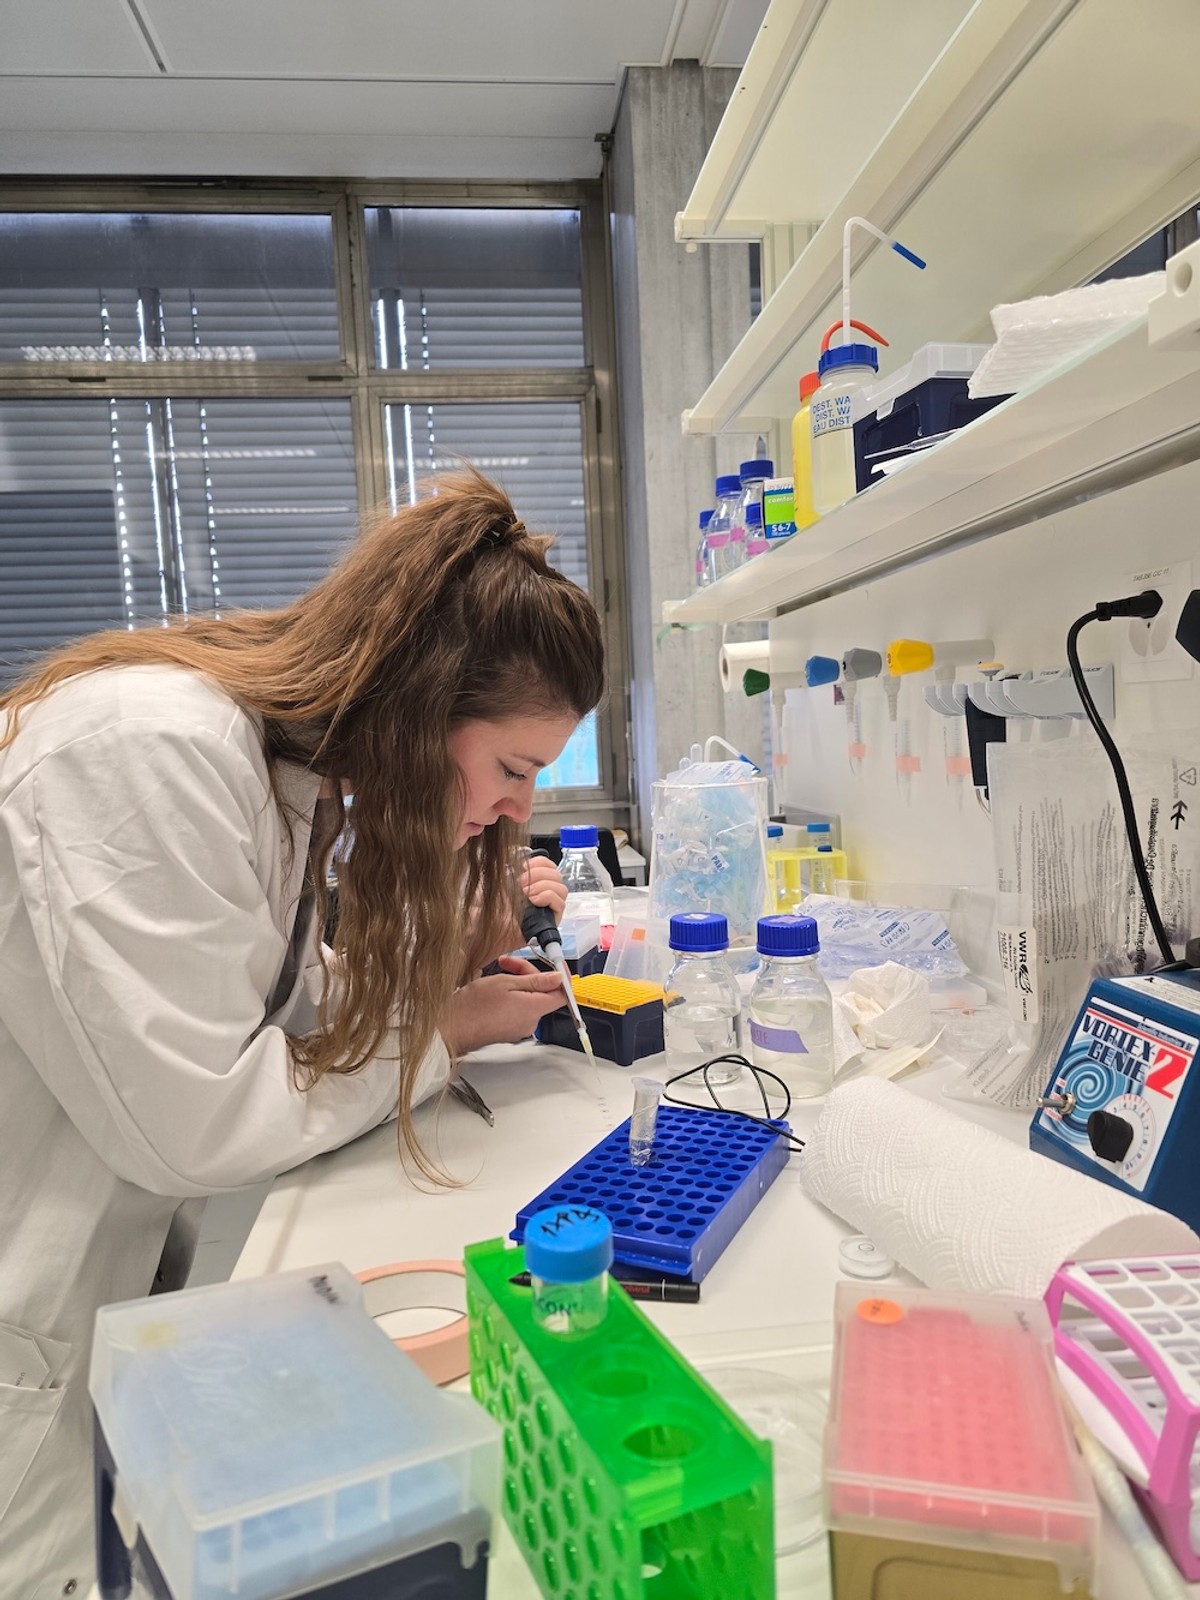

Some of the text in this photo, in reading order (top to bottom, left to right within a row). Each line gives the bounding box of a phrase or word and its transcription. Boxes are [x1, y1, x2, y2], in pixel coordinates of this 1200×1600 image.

[834, 395, 851, 406] WA
[812, 415, 851, 434] EAU DIST
[1018, 930, 1027, 963] VWR
[1087, 1039, 1188, 1100] GENIE 2
